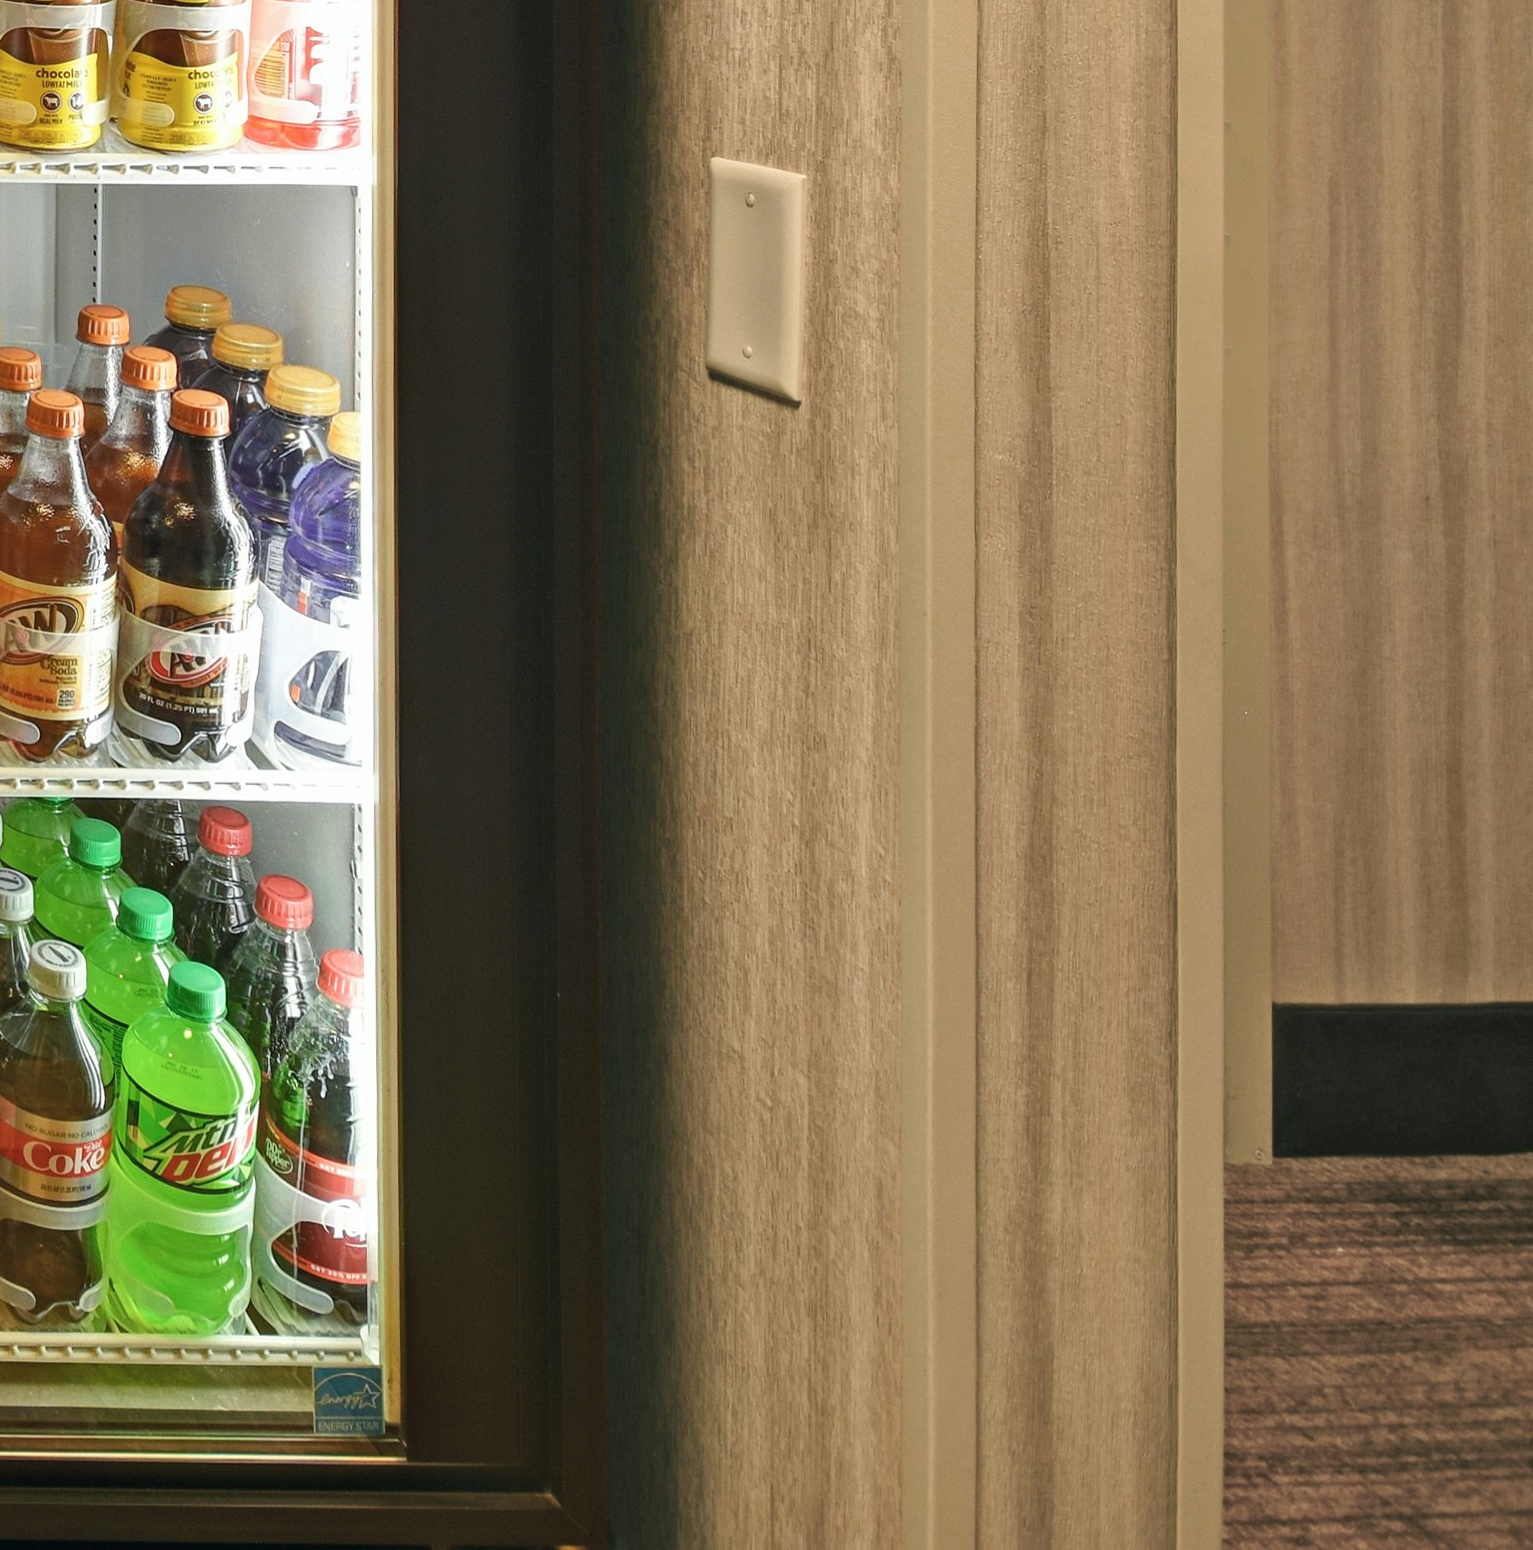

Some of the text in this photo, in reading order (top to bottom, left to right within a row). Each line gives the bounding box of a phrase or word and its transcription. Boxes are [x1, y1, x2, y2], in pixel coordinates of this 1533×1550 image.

[39, 656, 78, 668] Cream
[50, 666, 77, 675] Soda
[59, 690, 75, 700] 290
[23, 1140, 105, 1175] Coke
[318, 1421, 379, 1431] ENERGY STAR
